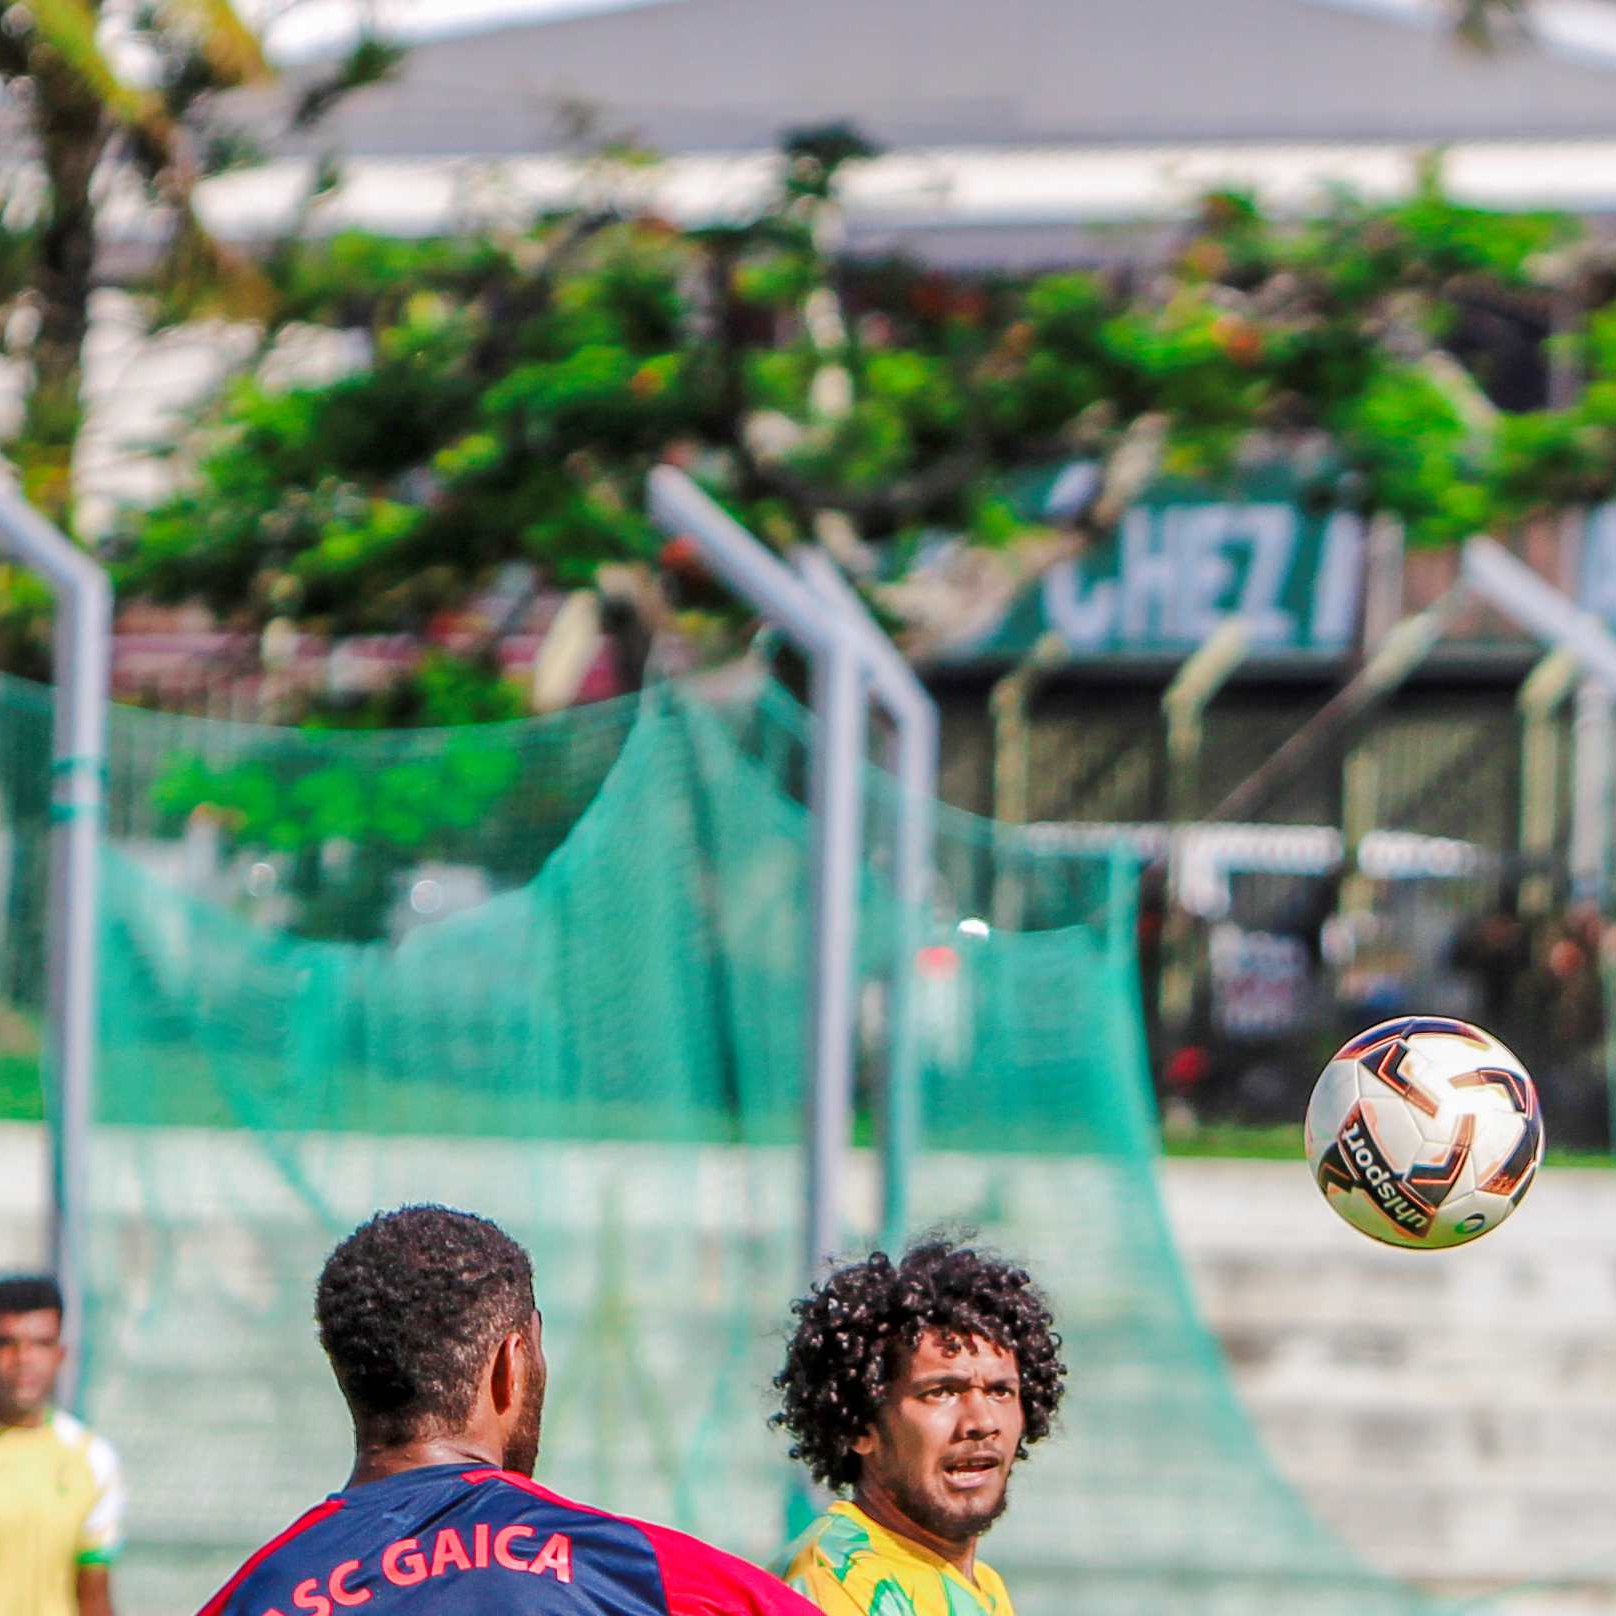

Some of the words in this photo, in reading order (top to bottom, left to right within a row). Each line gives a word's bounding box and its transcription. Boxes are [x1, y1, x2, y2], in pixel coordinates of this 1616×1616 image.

[1040, 502, 1299, 645] CHEZ
[1341, 1122, 1429, 1229] uhlsport
[381, 1523, 574, 1587] GAICA
